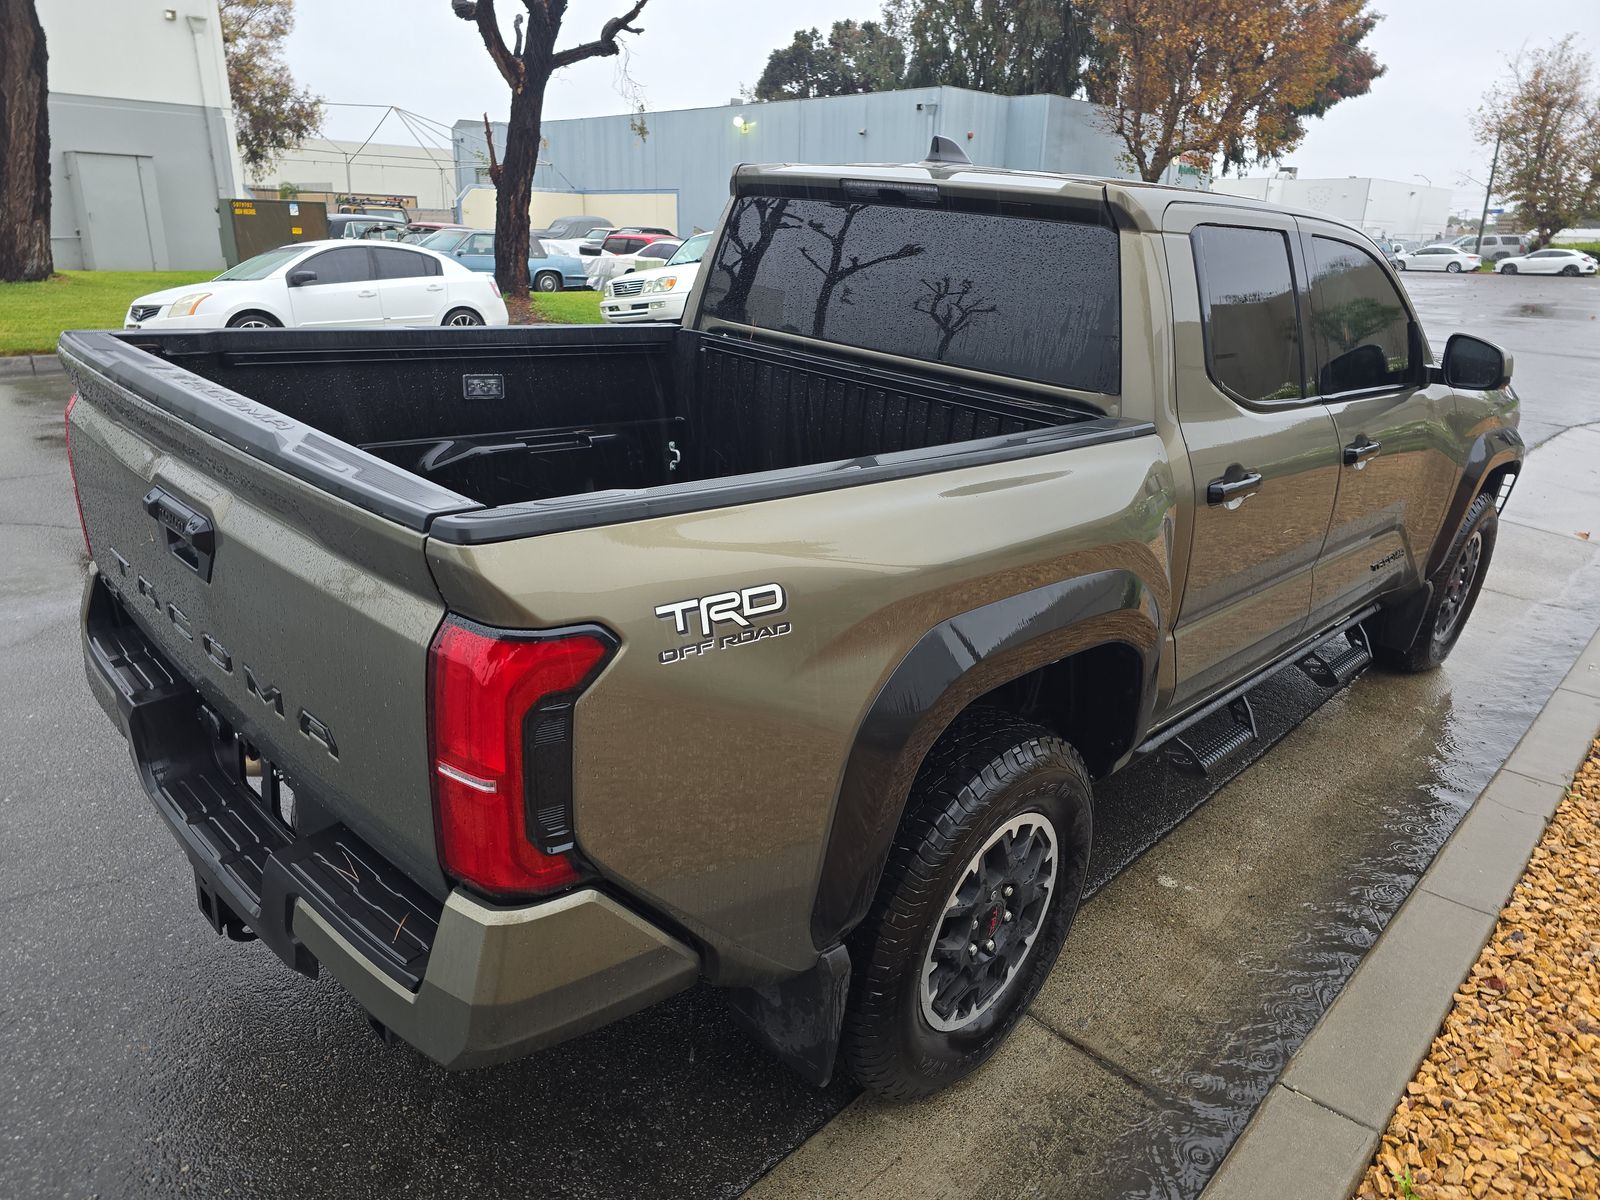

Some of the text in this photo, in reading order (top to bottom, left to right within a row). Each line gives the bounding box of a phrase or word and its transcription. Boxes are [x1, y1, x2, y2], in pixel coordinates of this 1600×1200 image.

[654, 583, 788, 638] TRD
[109, 547, 339, 762] TACOMA
[658, 621, 792, 665] OFF ROAD
